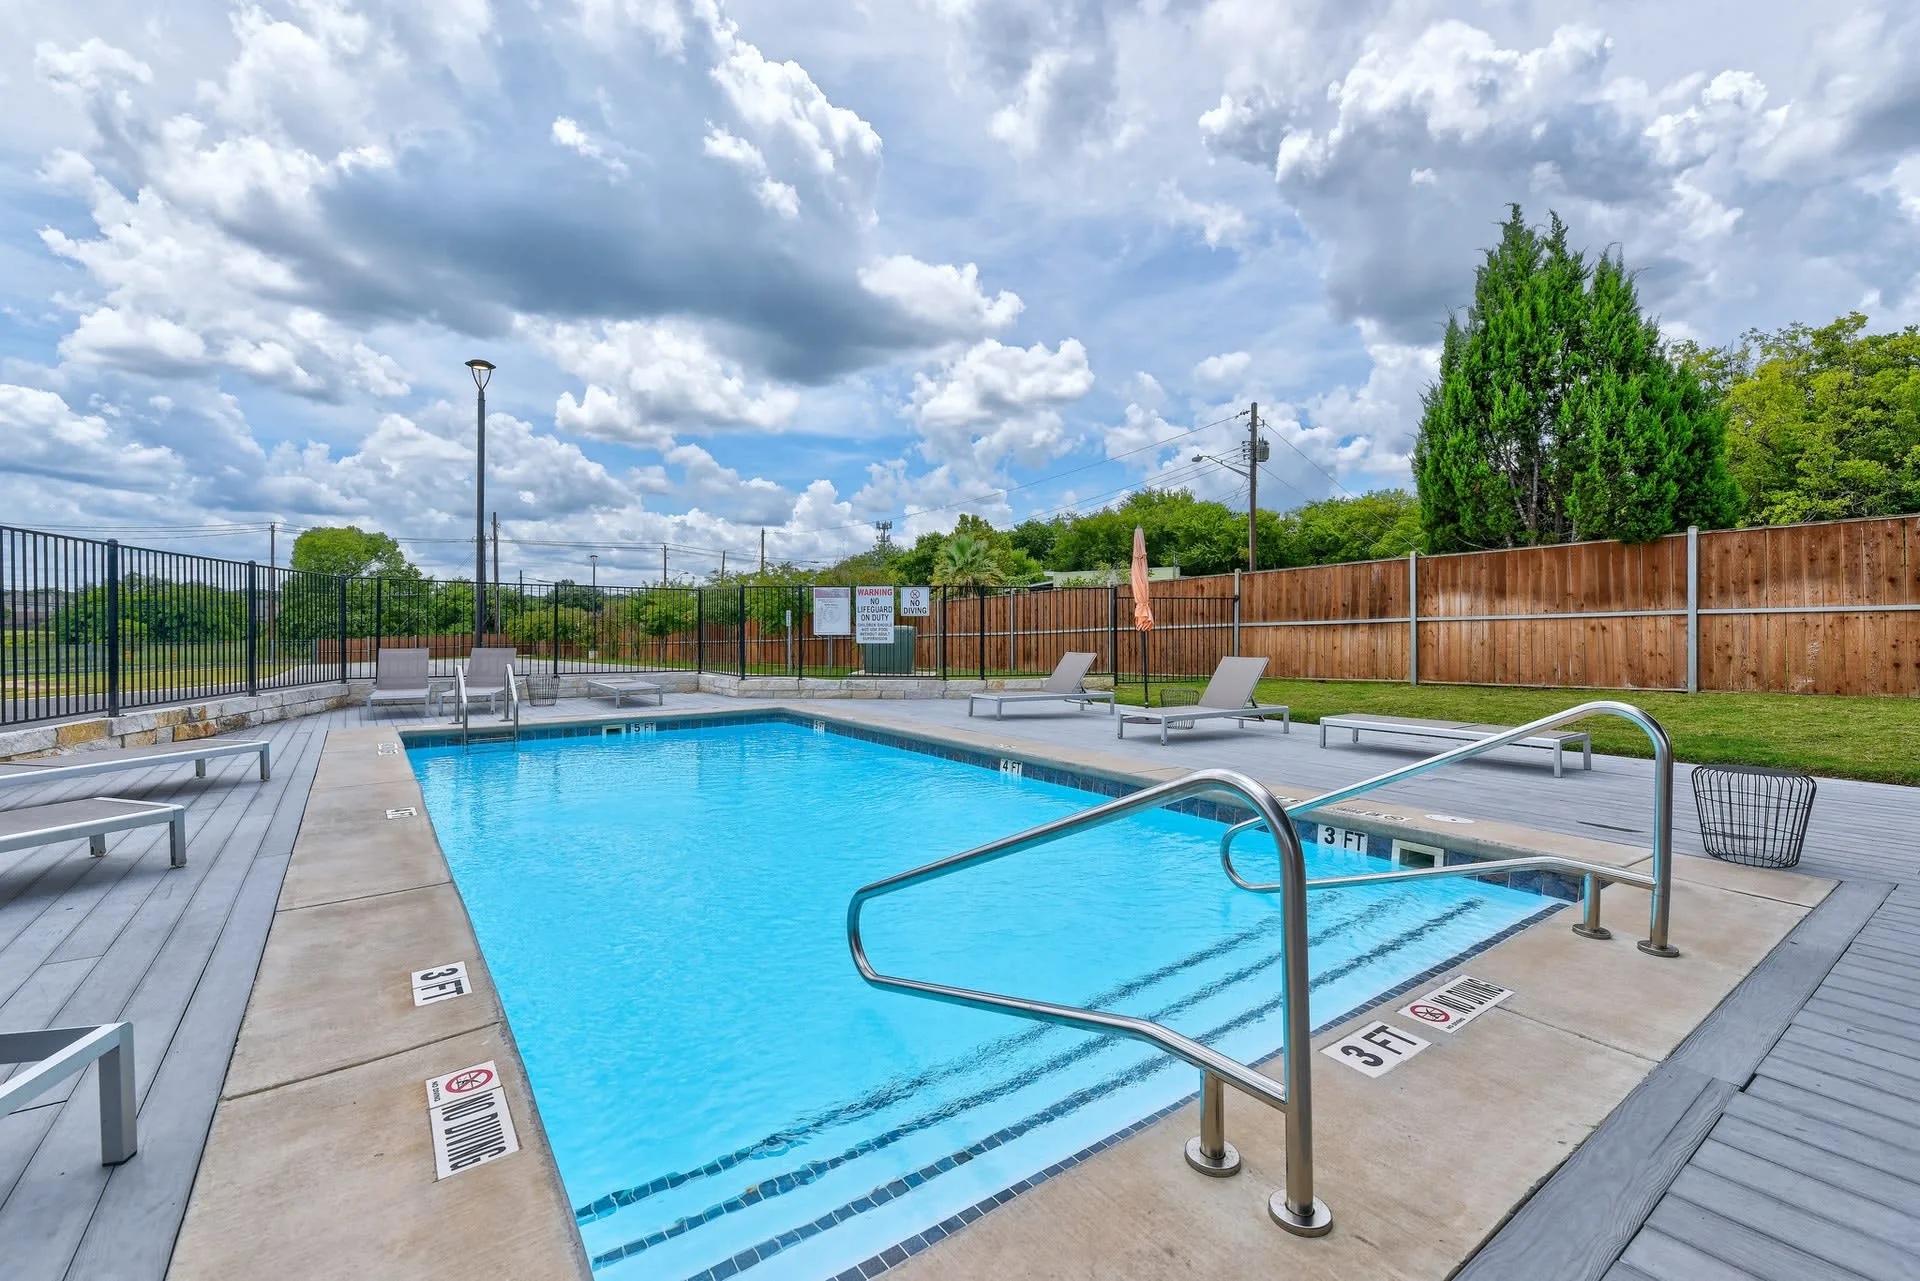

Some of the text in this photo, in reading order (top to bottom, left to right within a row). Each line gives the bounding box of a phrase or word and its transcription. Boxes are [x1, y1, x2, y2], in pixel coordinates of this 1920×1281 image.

[857, 588, 893, 597] WARNING
[634, 722, 654, 735] 5 FT
[1003, 760, 1021, 774] 4 FT
[1324, 826, 1365, 851] 3 FT
[420, 967, 464, 1000] 3 FT
[1430, 978, 1504, 1015] NO DIVING
[1340, 1024, 1417, 1067] 3 FT
[432, 1080, 441, 1102] NO DIVING
[441, 1093, 506, 1171] NO DIVING
